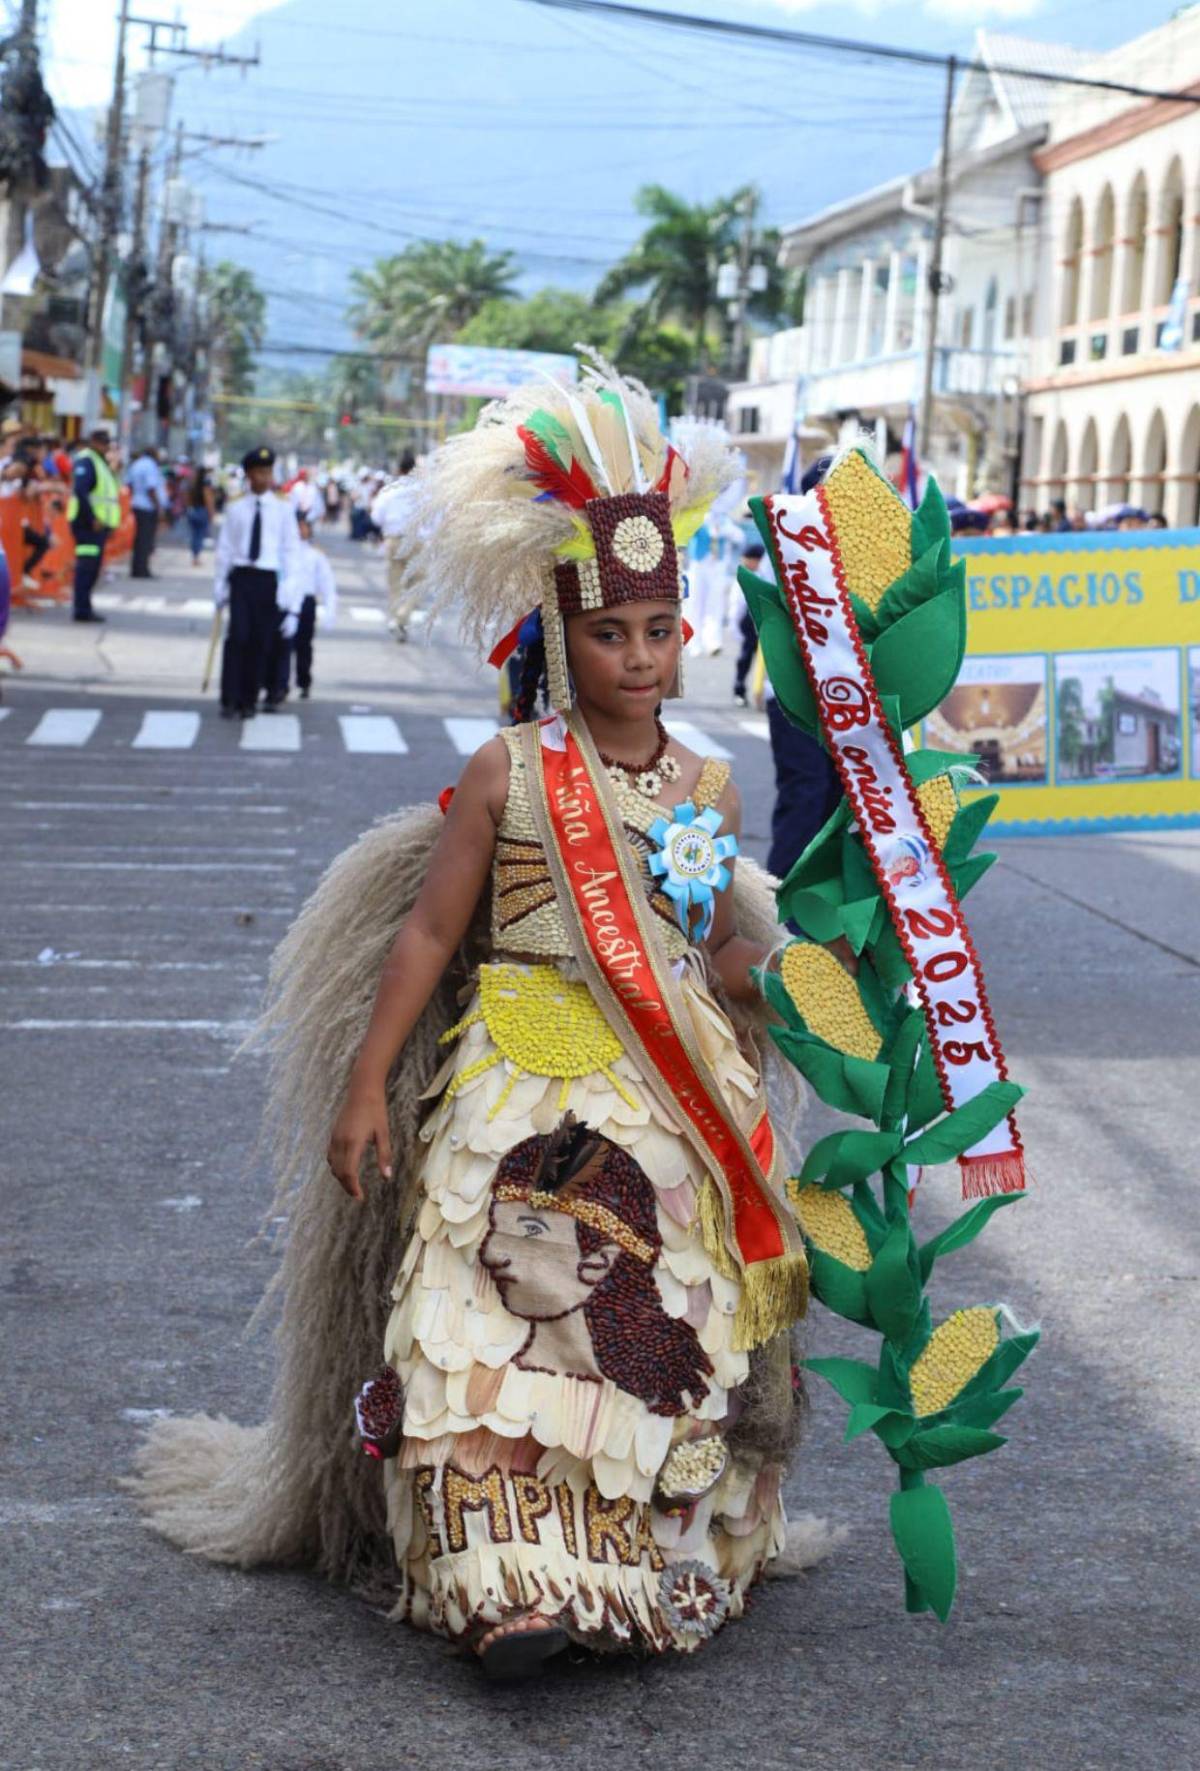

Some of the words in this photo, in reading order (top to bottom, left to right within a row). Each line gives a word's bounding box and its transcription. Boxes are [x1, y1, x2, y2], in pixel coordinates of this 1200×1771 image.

[968, 571, 1145, 611] ESPACIOS
[776, 509, 837, 647] India
[819, 677, 897, 834] Bonita
[903, 908, 991, 1066] 2025
[574, 860, 662, 1012] Ancestral
